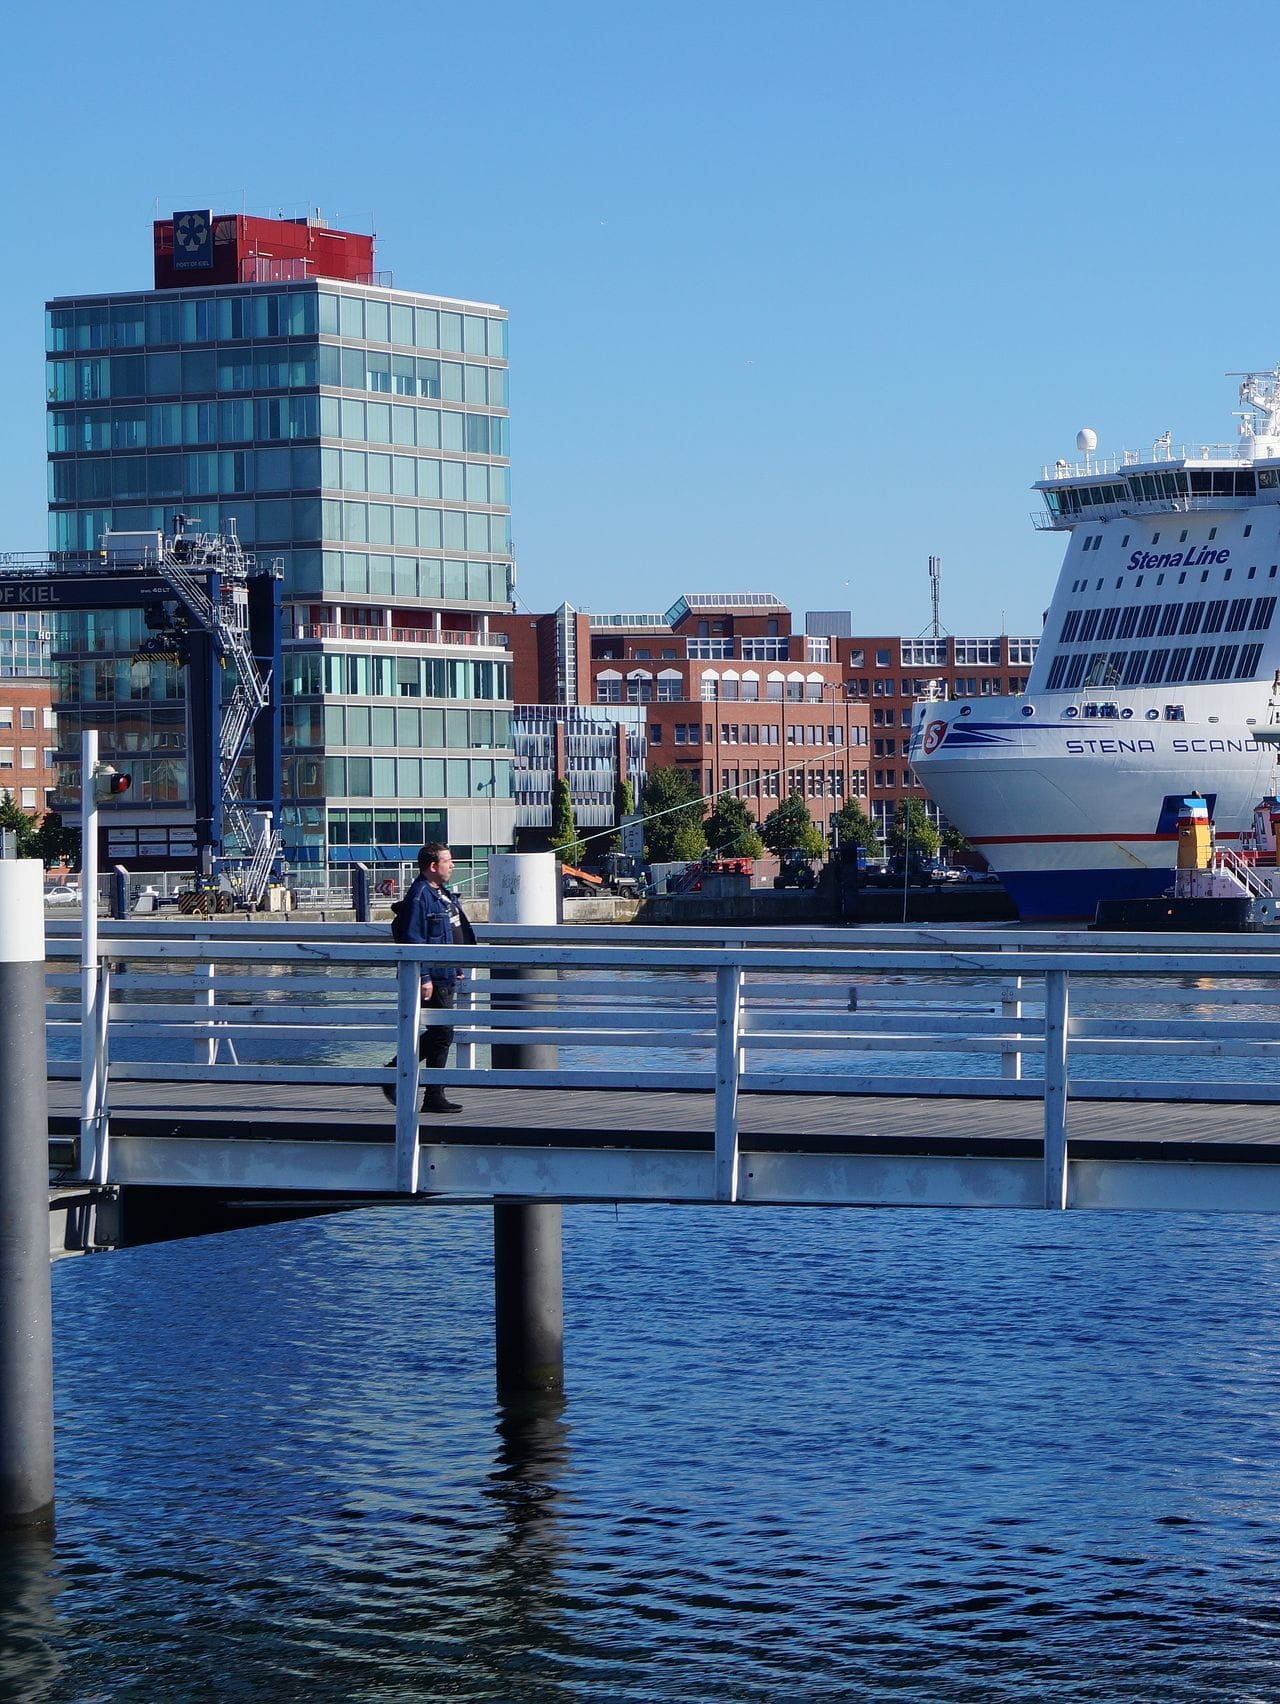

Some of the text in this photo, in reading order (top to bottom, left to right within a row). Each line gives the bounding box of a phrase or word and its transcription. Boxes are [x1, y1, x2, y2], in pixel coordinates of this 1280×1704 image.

[19, 586, 60, 602] KIEL
[38, 631, 69, 640] HOTEL
[1066, 739, 1155, 753] STENA
